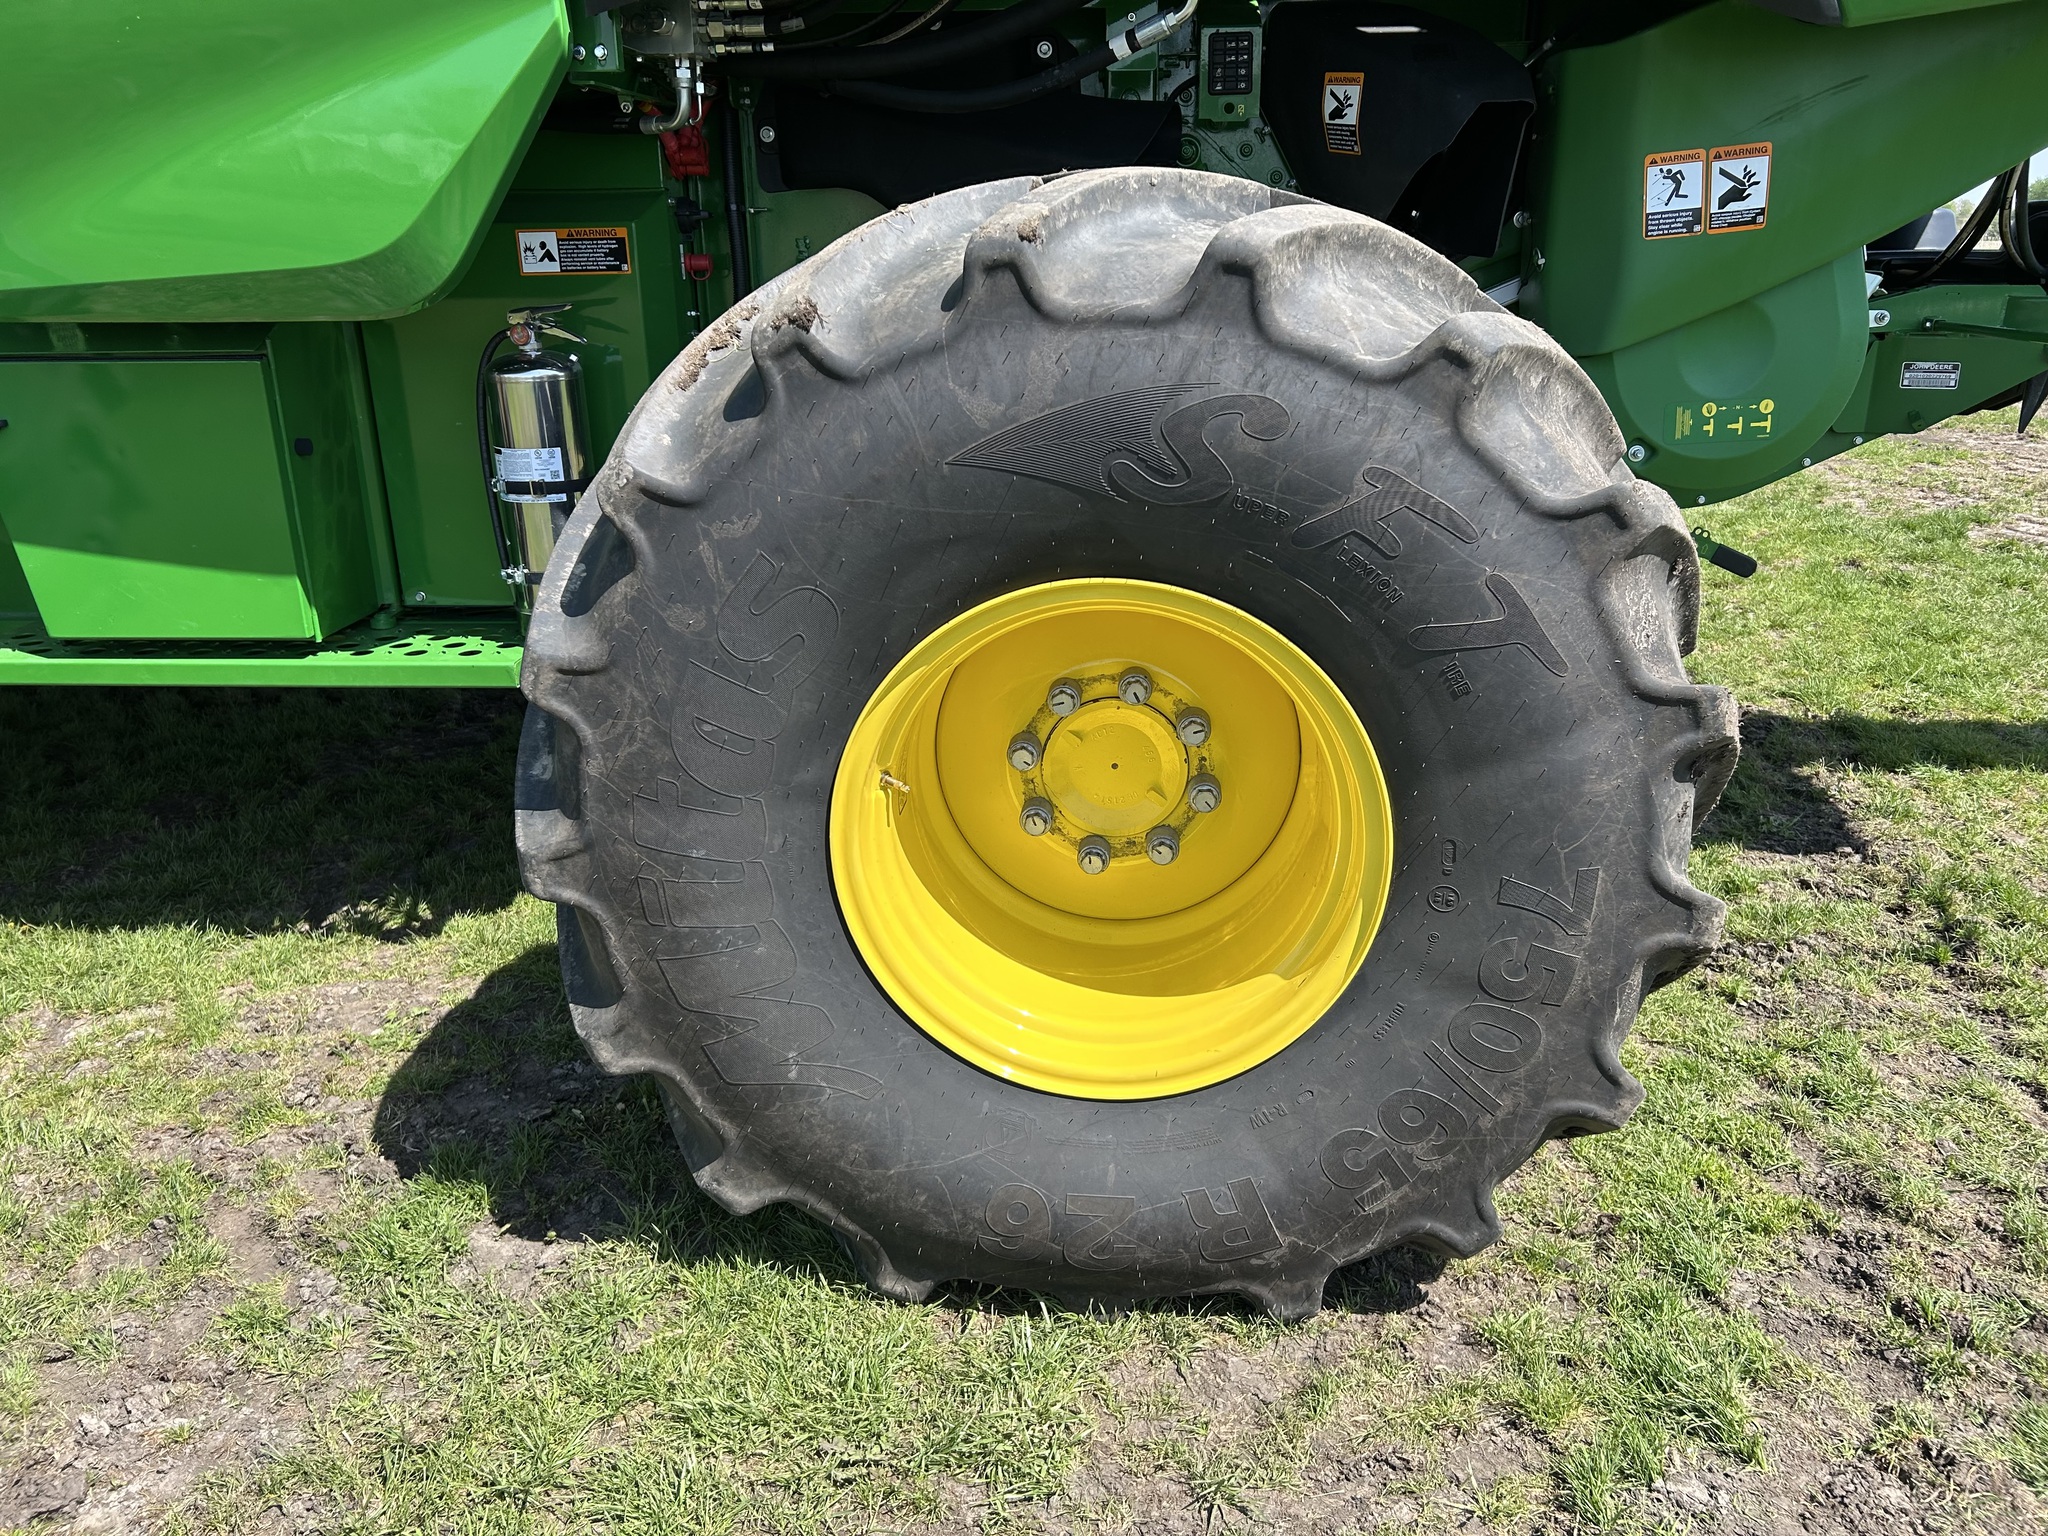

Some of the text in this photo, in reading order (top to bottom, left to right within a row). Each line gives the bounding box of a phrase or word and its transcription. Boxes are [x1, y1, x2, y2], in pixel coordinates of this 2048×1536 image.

[1660, 152, 1700, 163] WARNING
[1724, 146, 1768, 157] WARNING
[574, 229, 617, 237] WARNING
[1320, 867, 1601, 1213] 750/65
[978, 1183, 1138, 1270] 26
[1182, 1176, 1285, 1262] R
